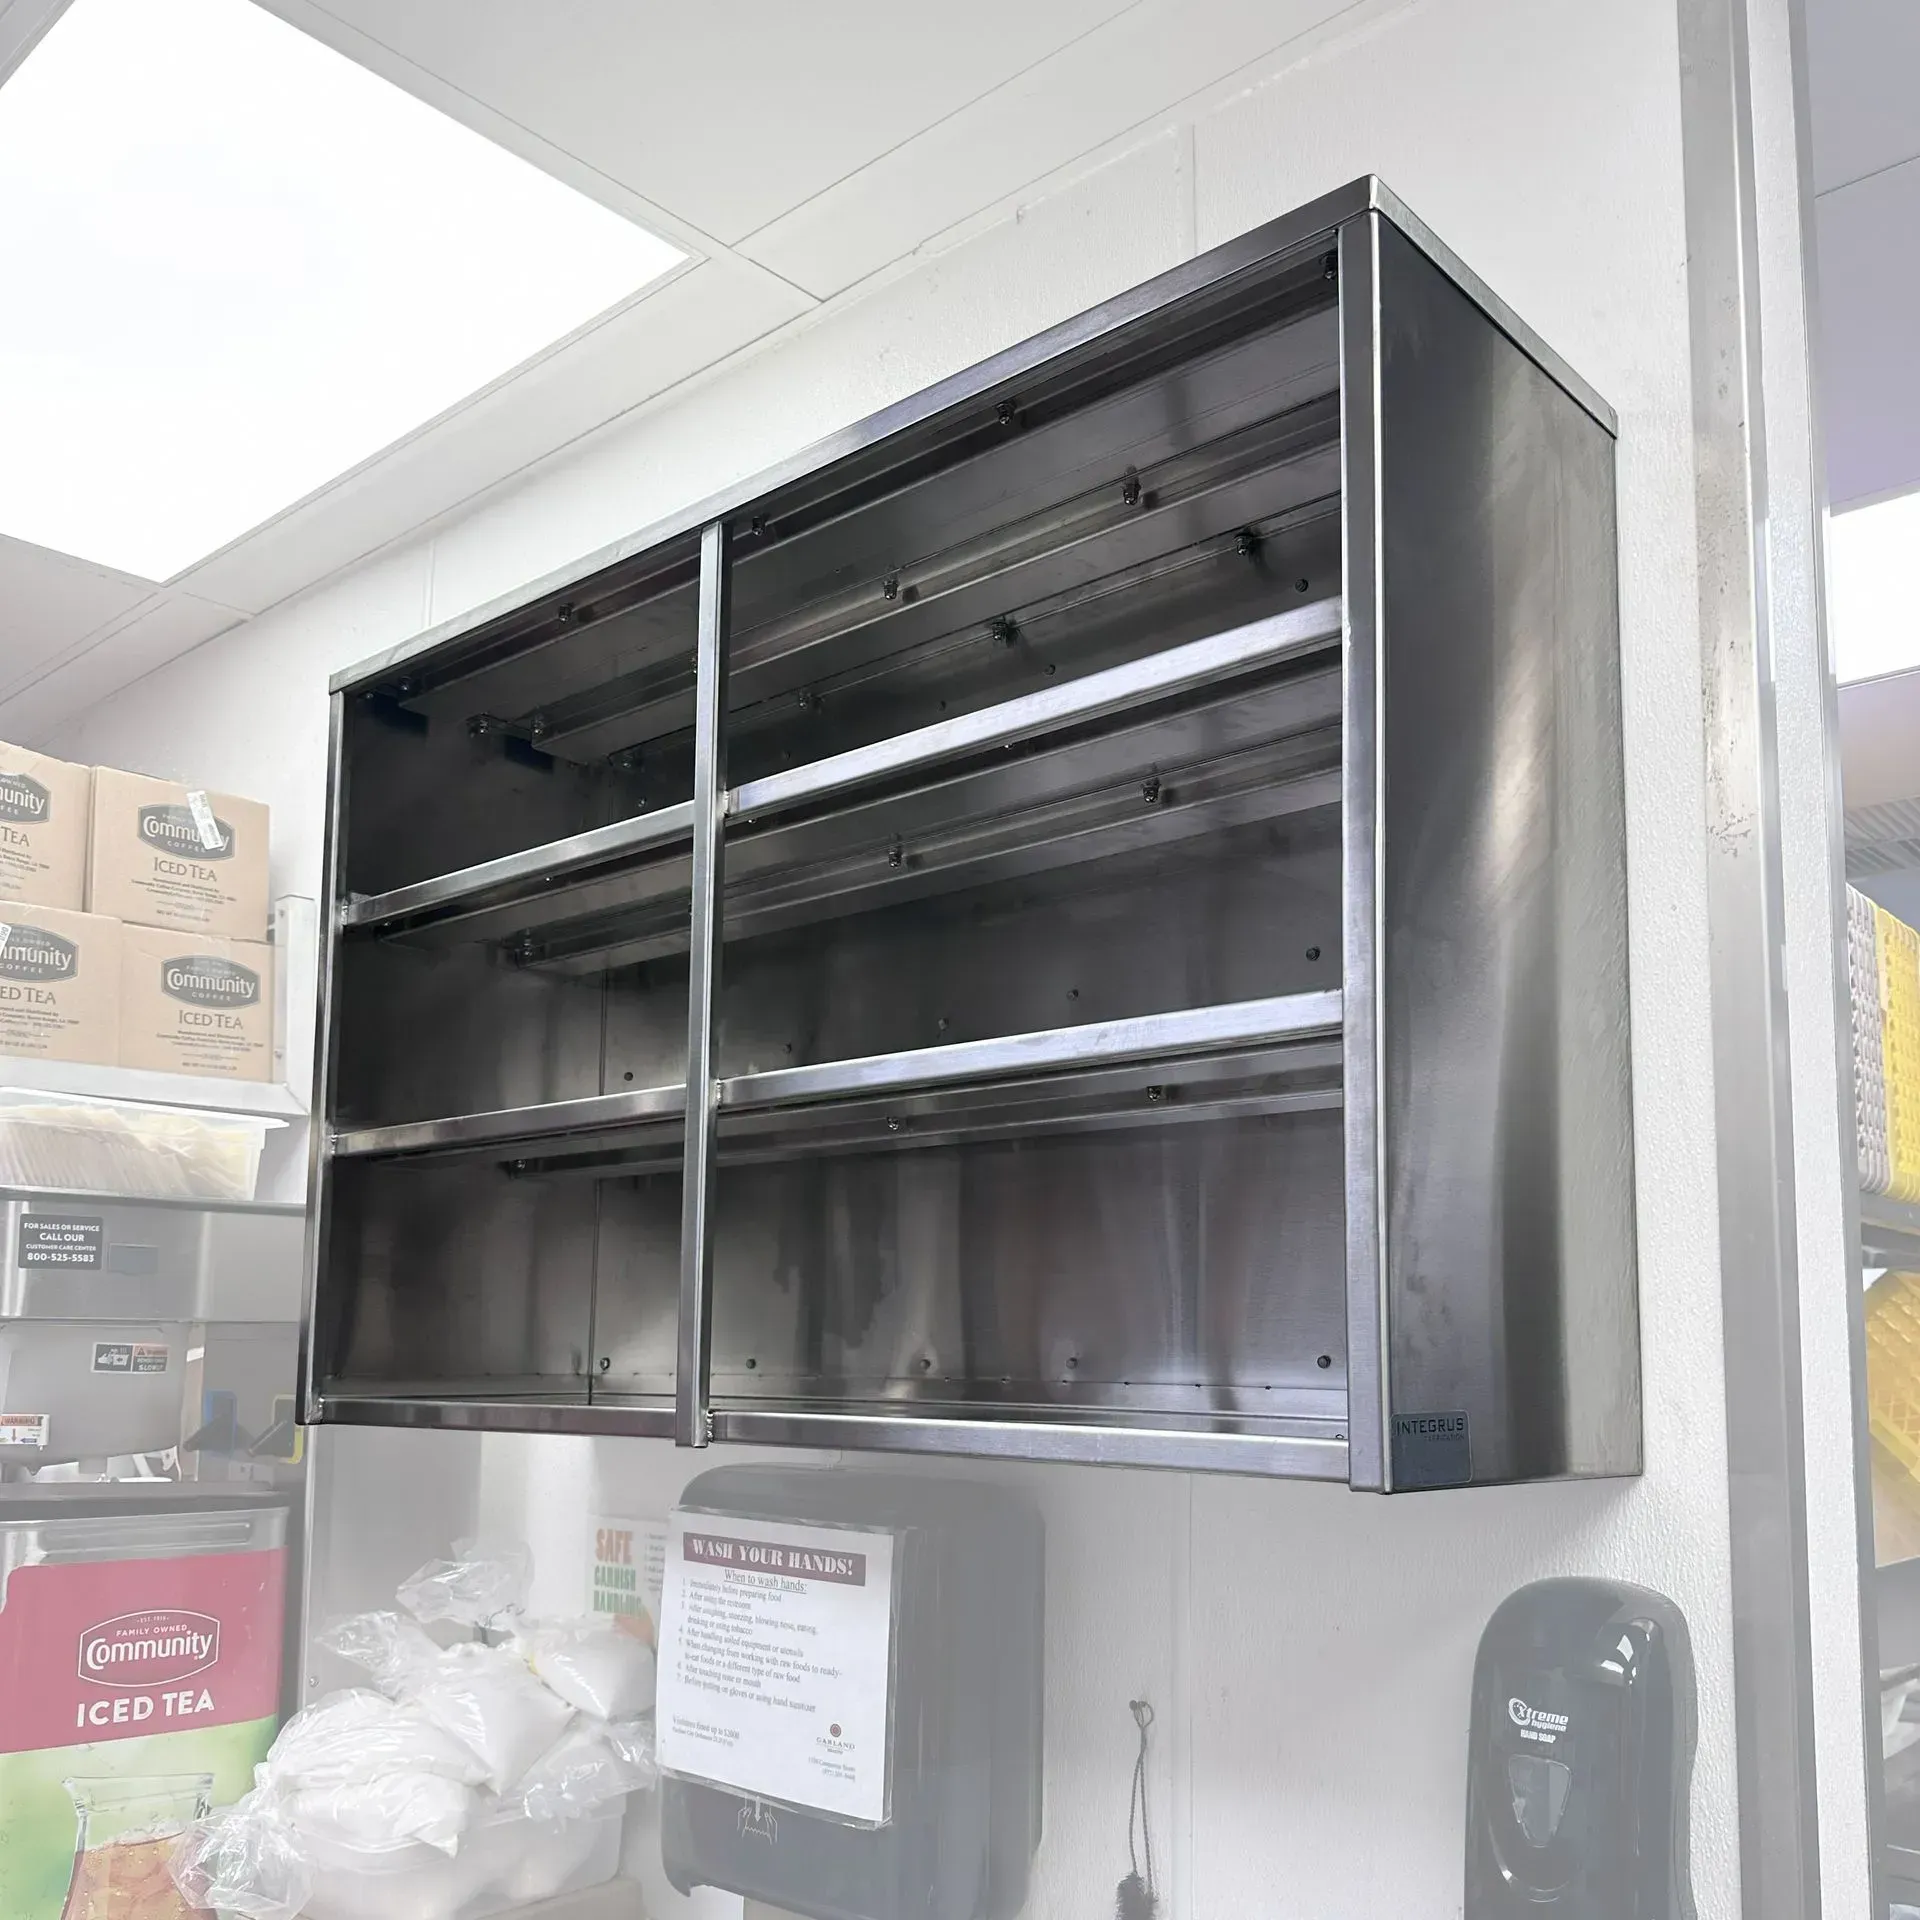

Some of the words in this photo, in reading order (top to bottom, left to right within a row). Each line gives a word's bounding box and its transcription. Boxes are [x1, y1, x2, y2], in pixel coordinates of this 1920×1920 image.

[1, 826, 30, 847] TEA
[143, 816, 230, 852] Commuy
[154, 857, 187, 876] ICED
[189, 864, 218, 882] TEA
[167, 968, 256, 998] Community
[24, 987, 56, 1005] TEA
[179, 1010, 213, 1027] ICED
[214, 1014, 244, 1030] TEA
[24, 1222, 39, 1230] FOR
[40, 1223, 60, 1231] SALES
[72, 1224, 100, 1232] SERVICE
[40, 1233, 63, 1241] CALL
[64, 1234, 85, 1242] OUR
[27, 1252, 95, 1263] 800-525-5583
[1396, 1417, 1465, 1436] INTEGRUS
[595, 1528, 634, 1565] SAFE
[692, 1539, 734, 1560] WASH
[738, 1544, 783, 1566] YOUR
[788, 1552, 853, 1576] HANDS!
[724, 1569, 746, 1584] When
[748, 1573, 756, 1584] to
[758, 1576, 779, 1589] wash
[780, 1578, 808, 1592] hands:
[689, 1591, 703, 1601] After
[739, 1590, 767, 1604] preparing
[768, 1591, 783, 1602] food
[688, 1604, 703, 1613] After
[755, 1615, 779, 1629] blowing
[117, 1628, 150, 1637] FAMILY
[154, 1624, 188, 1634] OWNED
[687, 1627, 700, 1637] After
[724, 1635, 741, 1646] soiled
[741, 1640, 771, 1652] equipment
[731, 1624, 753, 1635] tobacco
[86, 1630, 214, 1671] Community
[701, 1655, 715, 1666] foods
[727, 1660, 751, 1674] different
[752, 1666, 765, 1678] type
[765, 1668, 773, 1678] of
[773, 1672, 785, 1680] raw
[786, 1672, 801, 1683] food
[726, 1648, 740, 1658] from
[740, 1653, 764, 1666] working
[765, 1656, 779, 1667] with
[780, 1660, 791, 1668] raw
[792, 1661, 811, 1673] foods
[812, 1665, 819, 1674] to
[820, 1666, 843, 1680] ready-
[729, 1687, 748, 1699] gloves
[748, 1692, 755, 1700] or
[773, 1696, 788, 1707] hand
[77, 1696, 154, 1728] ICED
[162, 1689, 215, 1717] TEA
[816, 1737, 856, 1750] GARLAND
[1539, 1733, 1556, 1744] SOAP
